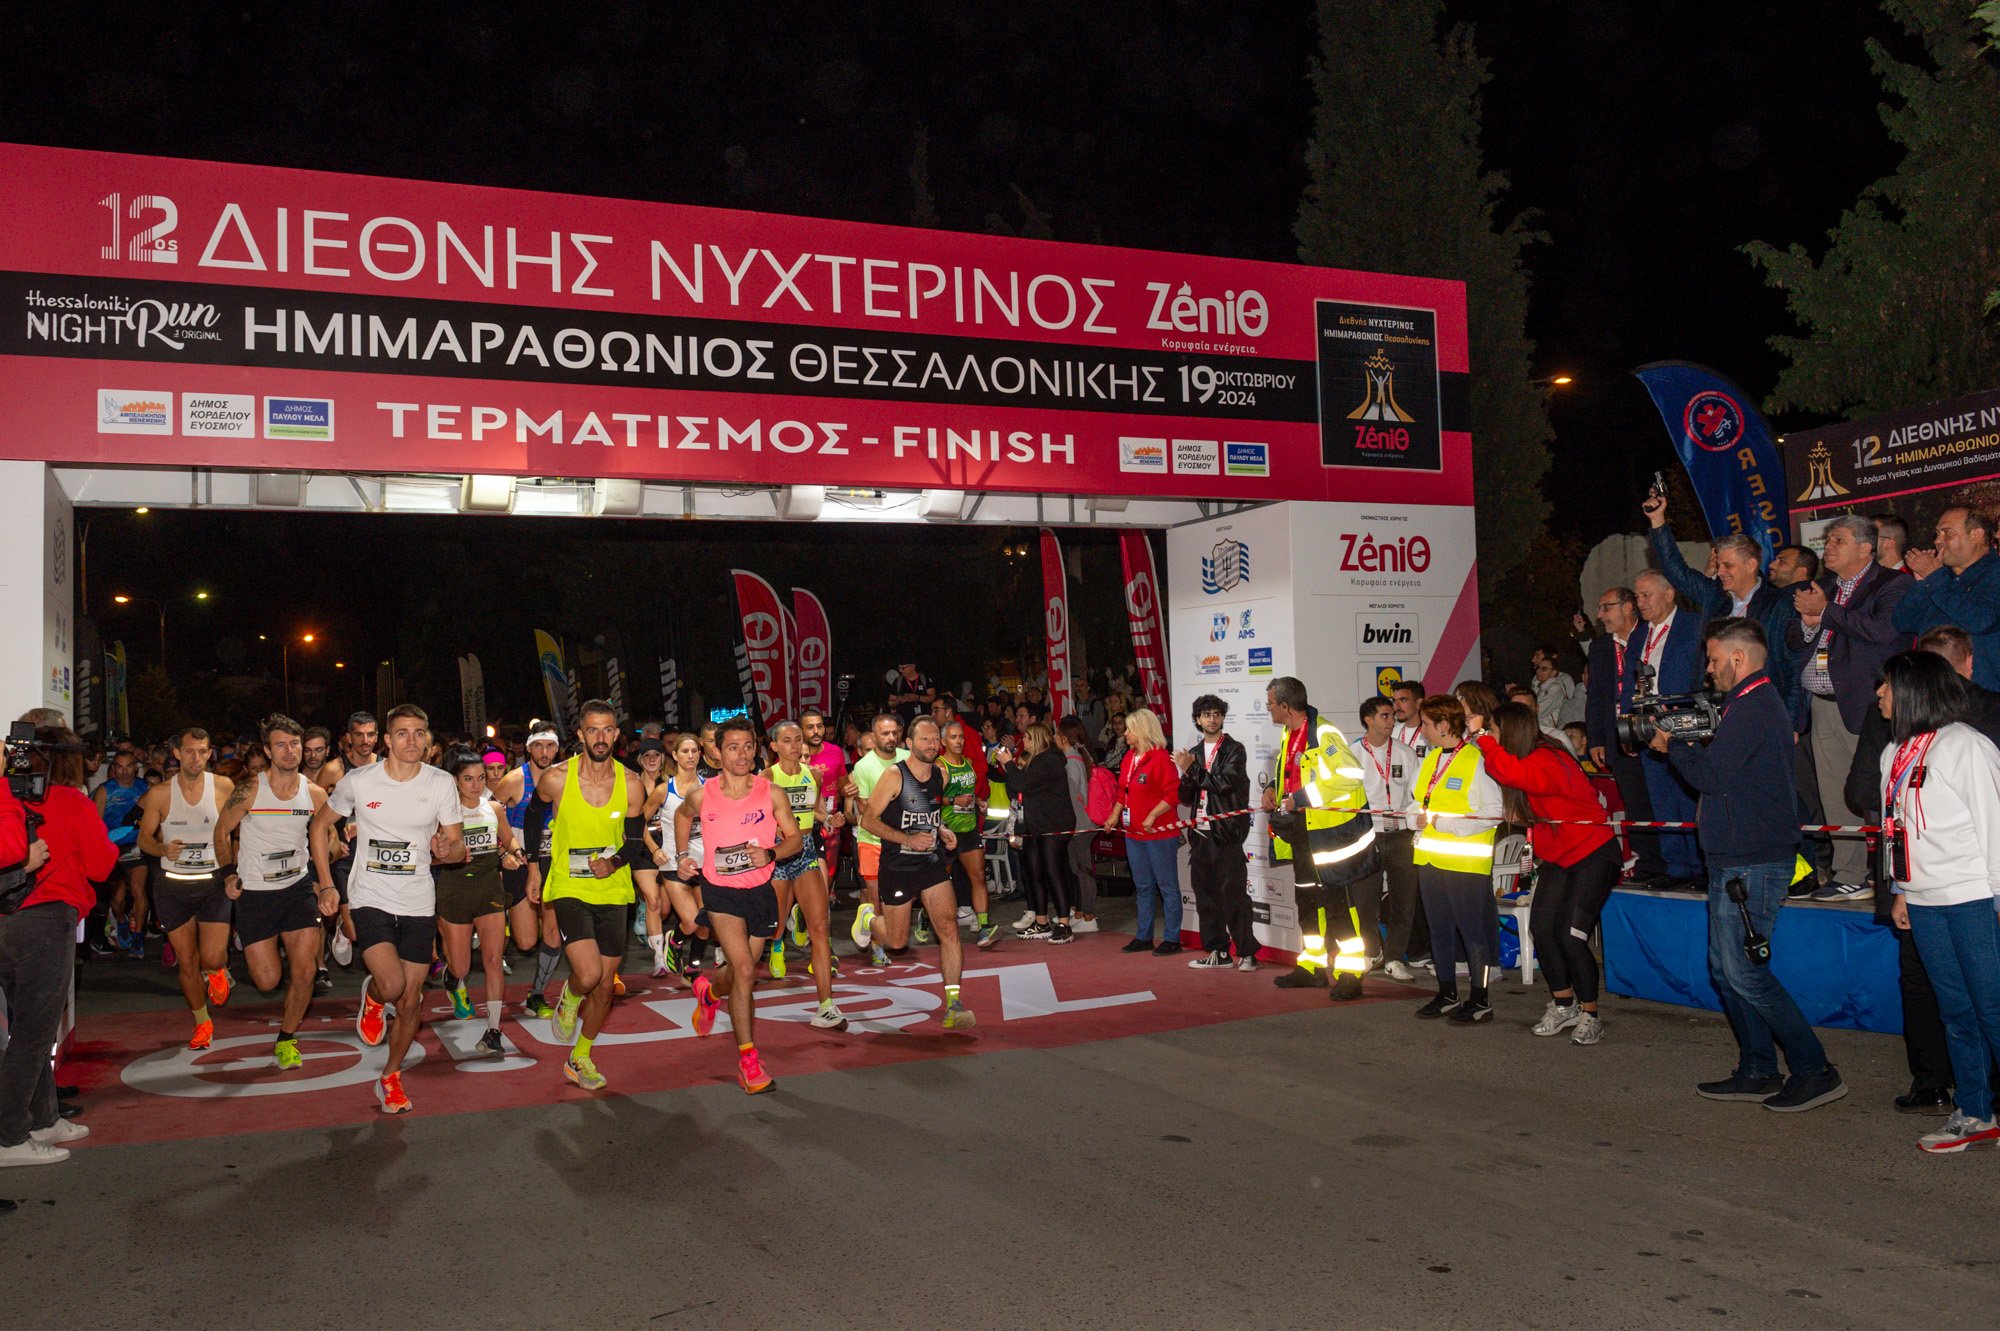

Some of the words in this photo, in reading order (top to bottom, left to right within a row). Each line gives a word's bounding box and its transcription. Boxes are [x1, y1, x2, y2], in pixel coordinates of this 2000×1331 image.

[198, 202, 615, 298] ΔΙΕΘΝΗΣ
[651, 240, 1117, 335] ΝΥΧΤΕΡΙΝΟΣ
[26, 290, 130, 311] thessaloniki
[26, 311, 128, 345] NIGHT
[125, 299, 221, 350] Run
[1368, 318, 1415, 331] ΝΥΧΤΕΡΙΝΟΣ
[1323, 329, 1383, 342] ΗΜΙΜΑΡΑΘΩΝΙΟΣ
[1161, 338, 1211, 353] Κορυφαία
[244, 306, 774, 381] ΗΜΙΜΑΡΑΘΩΝΙΟΣ
[789, 342, 1166, 403] ΘΕΣΣΑΛΟΝΙΚΗΣ
[1177, 365, 1216, 405] 19
[1214, 370, 1296, 391] ΟΚΤΩΒΡΙΟΥ
[190, 400, 229, 409] ΔΗΜΟΣ
[1217, 390, 1256, 406] 2024
[284, 404, 314, 413] ΔΗΜΟΣ
[190, 410, 251, 421] ΚΟΡΔΕΛΙΟΥ
[272, 413, 303, 422] ΠΑΥΛΟΥ
[303, 414, 325, 422] ΜΕΛΑ
[190, 421, 243, 431] ΕΥΟΣΜΟΥ
[1887, 412, 1977, 449] ΔΙΕΘΝΗΣ
[376, 402, 850, 456] ΤΕΡΜΑΤΙΣΜΟΣ
[893, 426, 1075, 465] FINISH
[1177, 453, 1217, 461] ΚΟΡΔΕΛΙΟΥ
[1177, 462, 1212, 470] ΕΥΟΣΜΟΥ
[1863, 472, 1886, 487] Δρόμοι
[1887, 467, 1910, 483] Υγείας
[1911, 467, 1923, 476] και
[1923, 458, 1962, 475] Δυναμικού
[1350, 578, 1387, 588] Κορυφαία
[1238, 628, 1255, 640] AIMS
[366, 801, 383, 809] 4F
[791, 794, 806, 803] 139
[465, 833, 492, 846] 1802
[188, 850, 202, 860] 23
[376, 848, 411, 863] 1063
[725, 852, 747, 865] 678
[280, 859, 288, 869] 11
